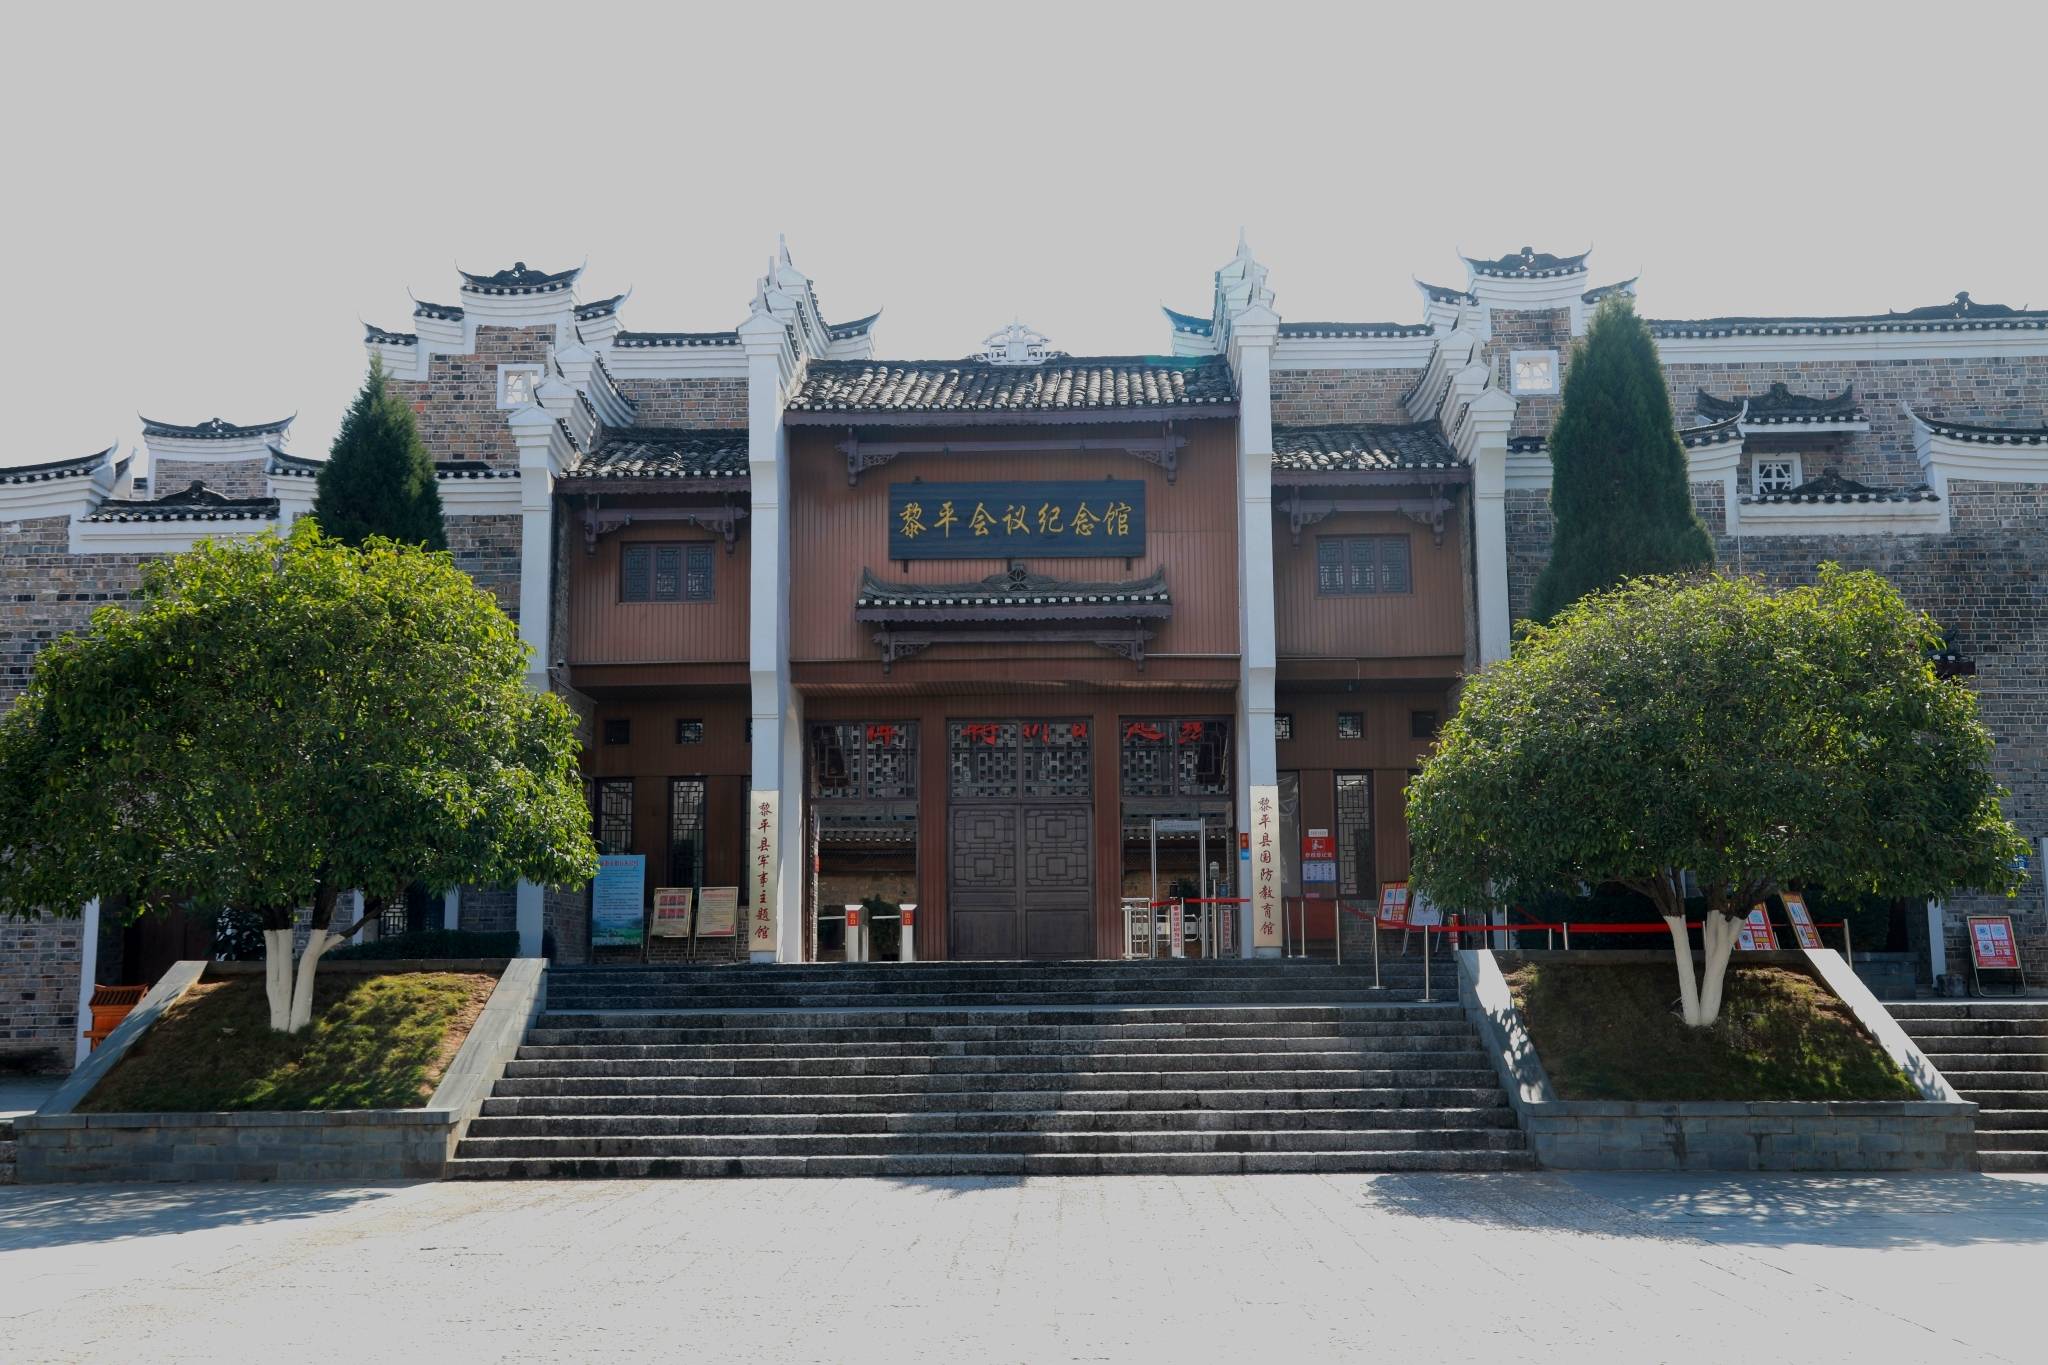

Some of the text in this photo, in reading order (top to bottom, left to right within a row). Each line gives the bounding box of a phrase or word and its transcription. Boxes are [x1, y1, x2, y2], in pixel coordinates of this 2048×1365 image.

[899, 501, 1132, 538] 黎平会议纪念馆
[754, 802, 772, 940] 黎平县军事主题馆
[1258, 797, 1275, 936] 黎平县国防教育馆
